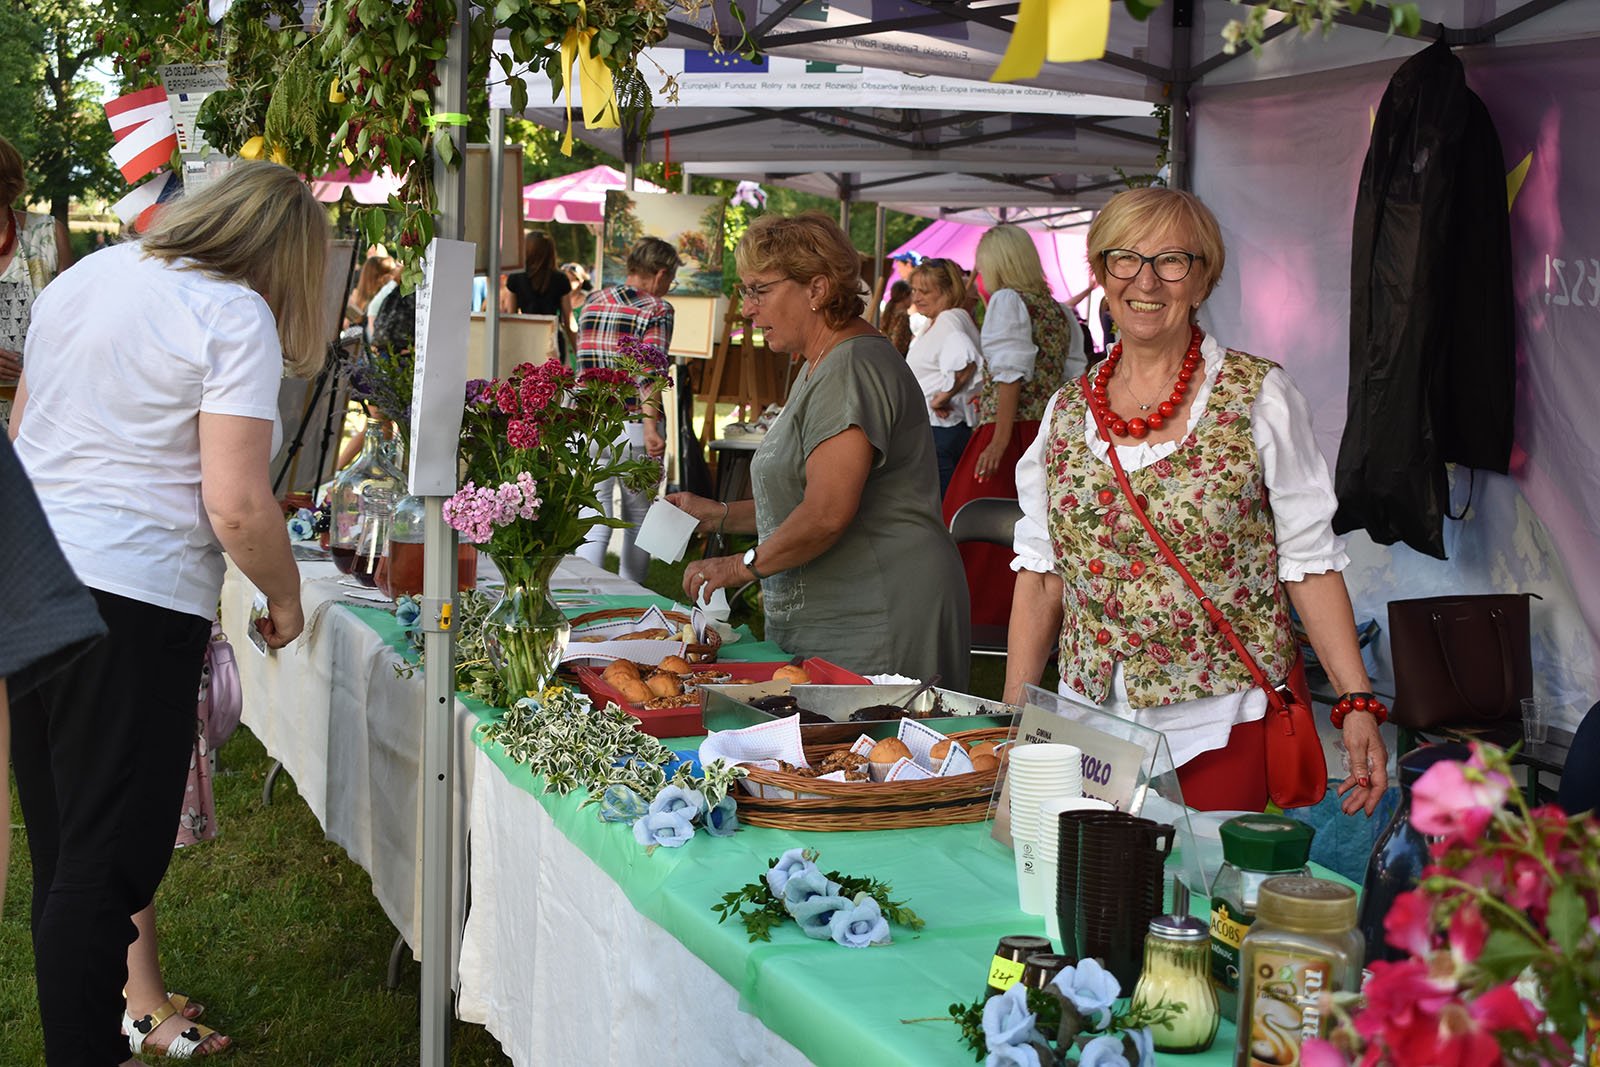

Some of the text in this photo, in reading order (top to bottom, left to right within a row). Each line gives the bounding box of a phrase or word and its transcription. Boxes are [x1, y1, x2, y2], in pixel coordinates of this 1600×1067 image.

[724, 82, 757, 90] Fundusz
[760, 82, 784, 91] Rolny
[825, 82, 858, 91] Rozwoju
[861, 82, 899, 92] Obszarów
[940, 85, 968, 94] Europa
[970, 86, 1014, 96] inwestująca
[1023, 88, 1055, 97] obszary
[1210, 917, 1240, 943] ACOBS
